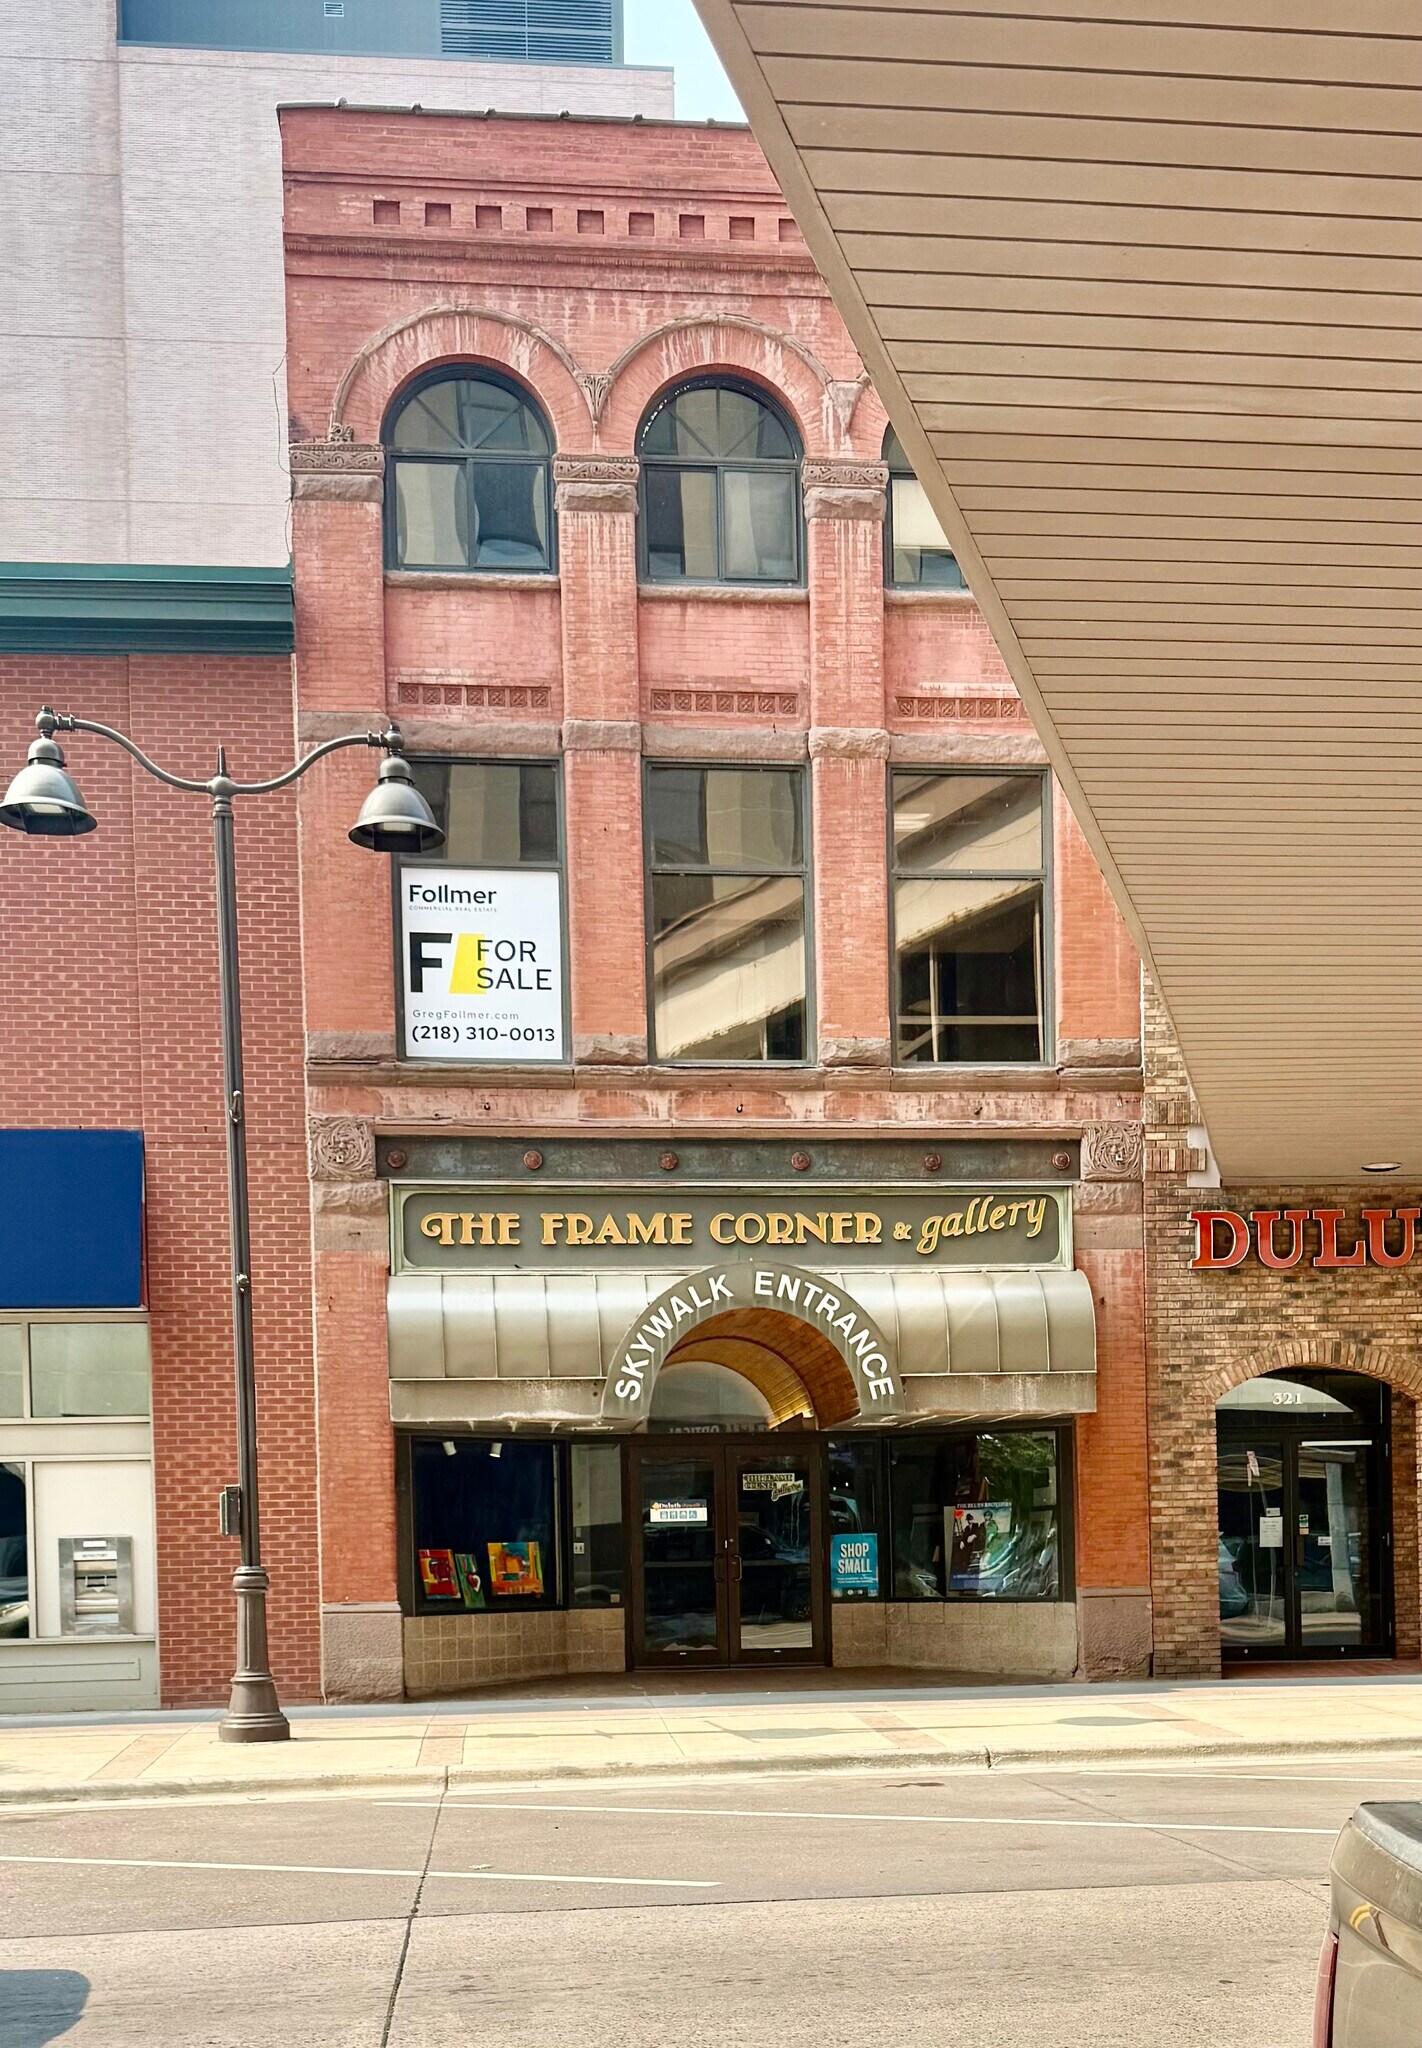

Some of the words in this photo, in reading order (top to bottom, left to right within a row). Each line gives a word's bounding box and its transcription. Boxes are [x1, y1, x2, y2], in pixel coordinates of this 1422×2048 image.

[409, 884, 497, 904] Follmer
[477, 939, 537, 963] FOR
[476, 967, 552, 991] SALE
[412, 1009, 519, 1021] GregFollmer.com
[412, 1025, 460, 1043] (218)
[466, 1026, 555, 1042] 310-0013
[420, 1212, 521, 1245] THE
[540, 1212, 693, 1245] FRAME
[709, 1212, 883, 1245] CORNER
[893, 1221, 912, 1241] &
[916, 1195, 1047, 1255] gallery
[1187, 1208, 1421, 1269] DULU
[614, 1273, 734, 1401] SKYWALK
[754, 1271, 895, 1401] ENTRANCE
[1272, 1391, 1303, 1405] 321
[840, 1542, 870, 1558] SHOP
[837, 1558, 873, 1574] SMALL
